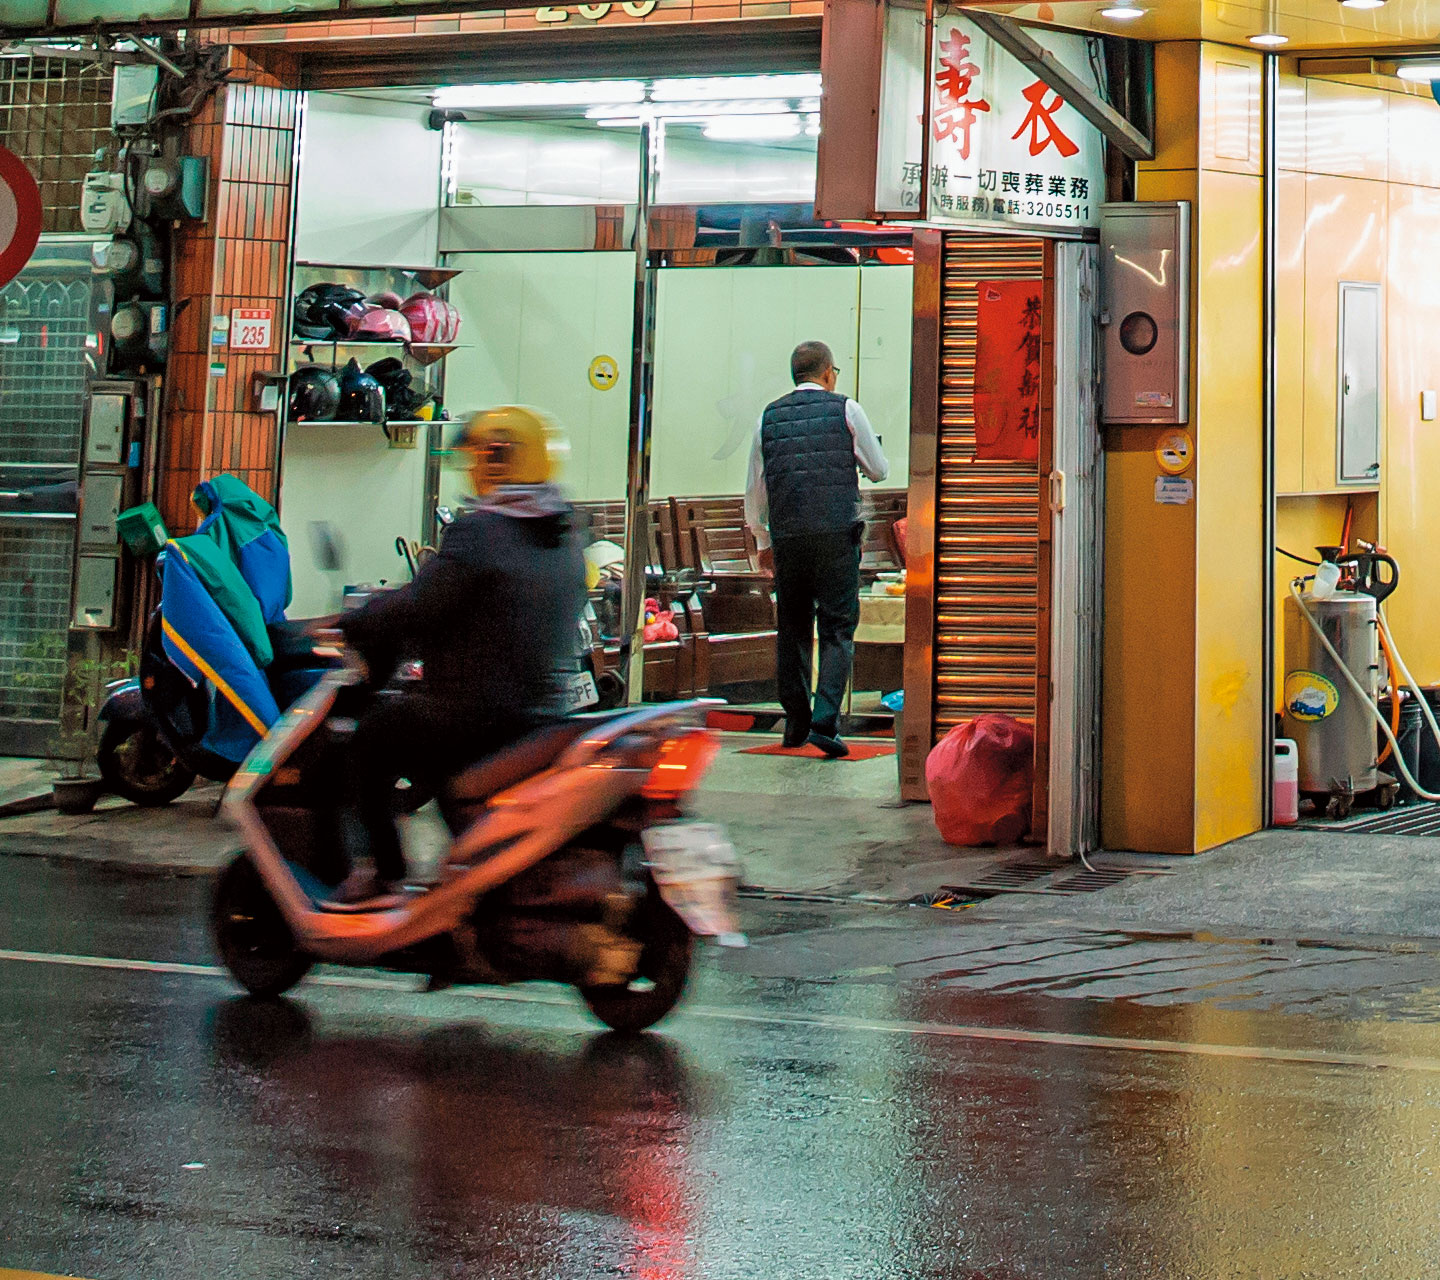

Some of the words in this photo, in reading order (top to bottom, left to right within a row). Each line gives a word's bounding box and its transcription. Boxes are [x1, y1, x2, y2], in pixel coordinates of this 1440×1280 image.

[916, 27, 1081, 162] 壽衣
[901, 160, 1091, 201] 承辦一切喪葬業務
[241, 325, 266, 345] 235
